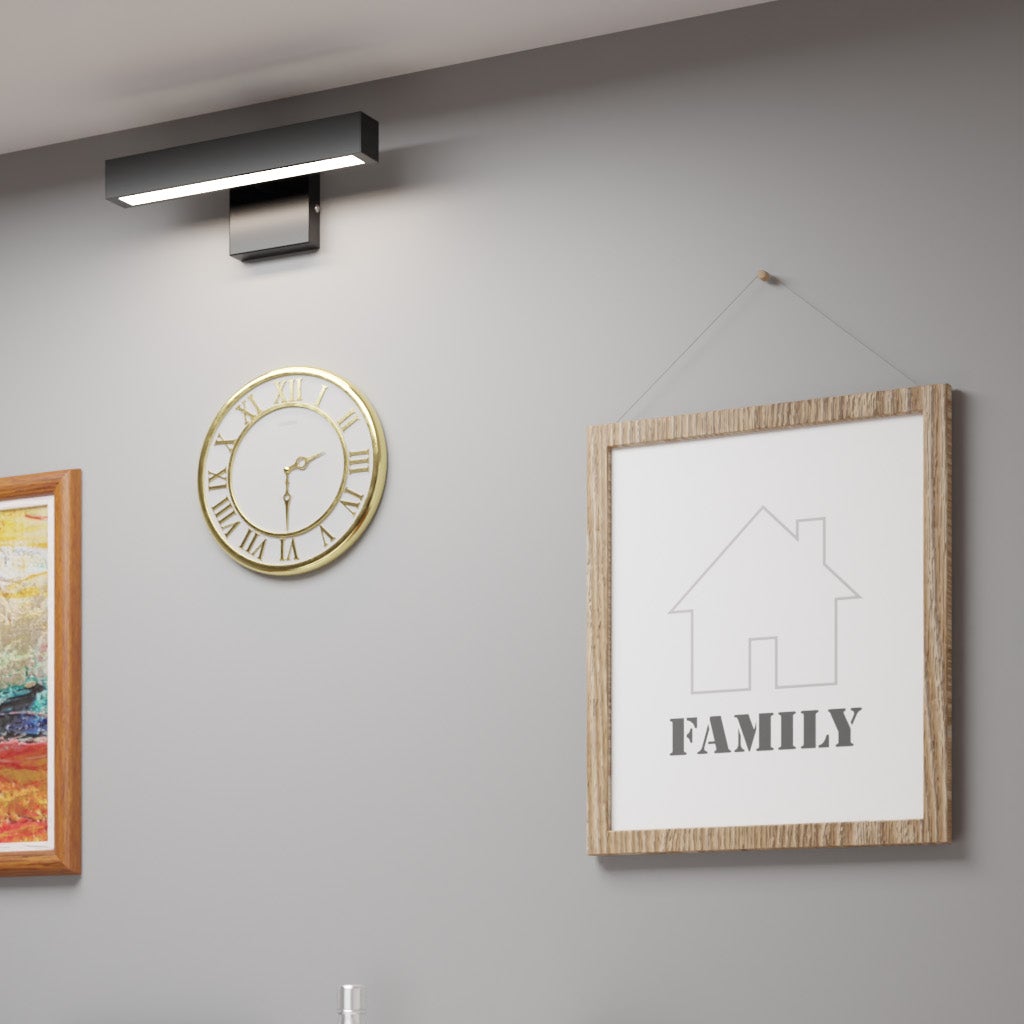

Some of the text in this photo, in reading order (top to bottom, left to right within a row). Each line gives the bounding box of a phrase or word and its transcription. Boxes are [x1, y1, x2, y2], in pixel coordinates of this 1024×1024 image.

[274, 377, 304, 404] XII
[236, 394, 263, 425] XI
[208, 468, 227, 491] IX
[240, 529, 267, 561] VII
[279, 537, 300, 561] VI
[669, 706, 862, 756] FAMILY
